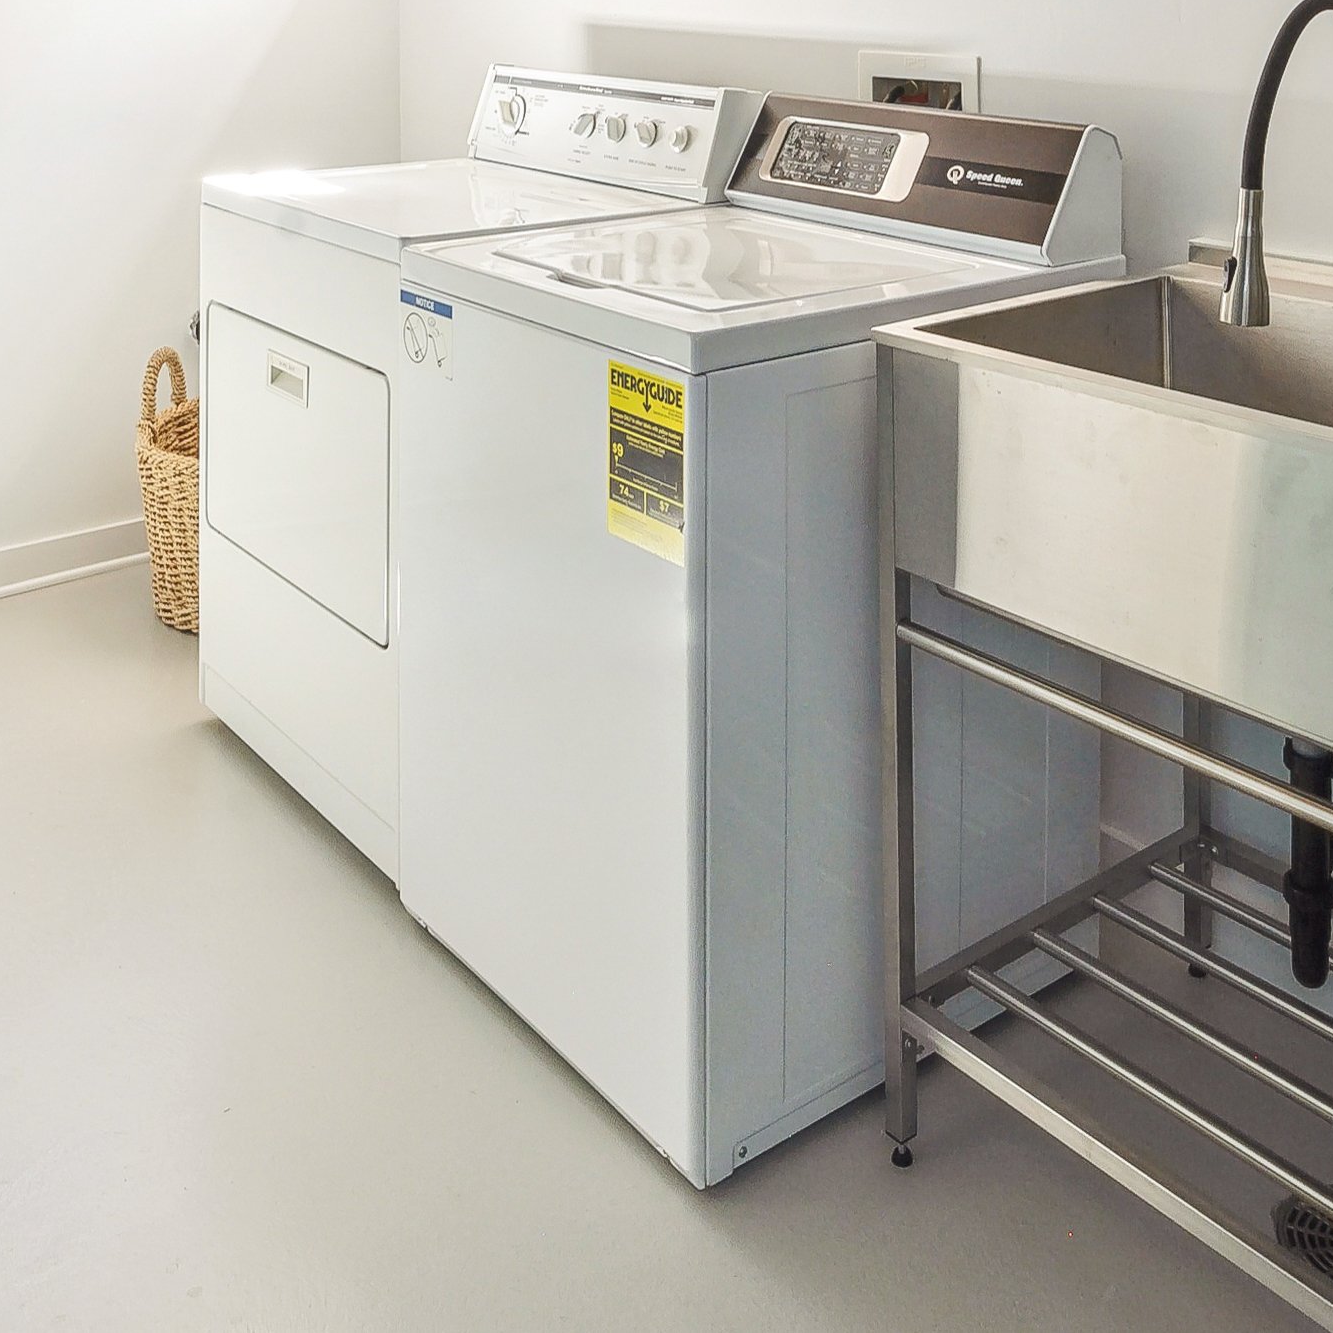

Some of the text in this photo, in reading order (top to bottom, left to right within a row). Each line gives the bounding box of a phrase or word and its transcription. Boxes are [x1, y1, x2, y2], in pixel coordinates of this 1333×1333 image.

[966, 170, 994, 181] Speed
[415, 296, 434, 311] NOTICE
[611, 368, 682, 409] ENERGYGUIDE
[612, 442, 623, 457] $9
[619, 484, 629, 496] 74
[659, 500, 670, 512] $7
